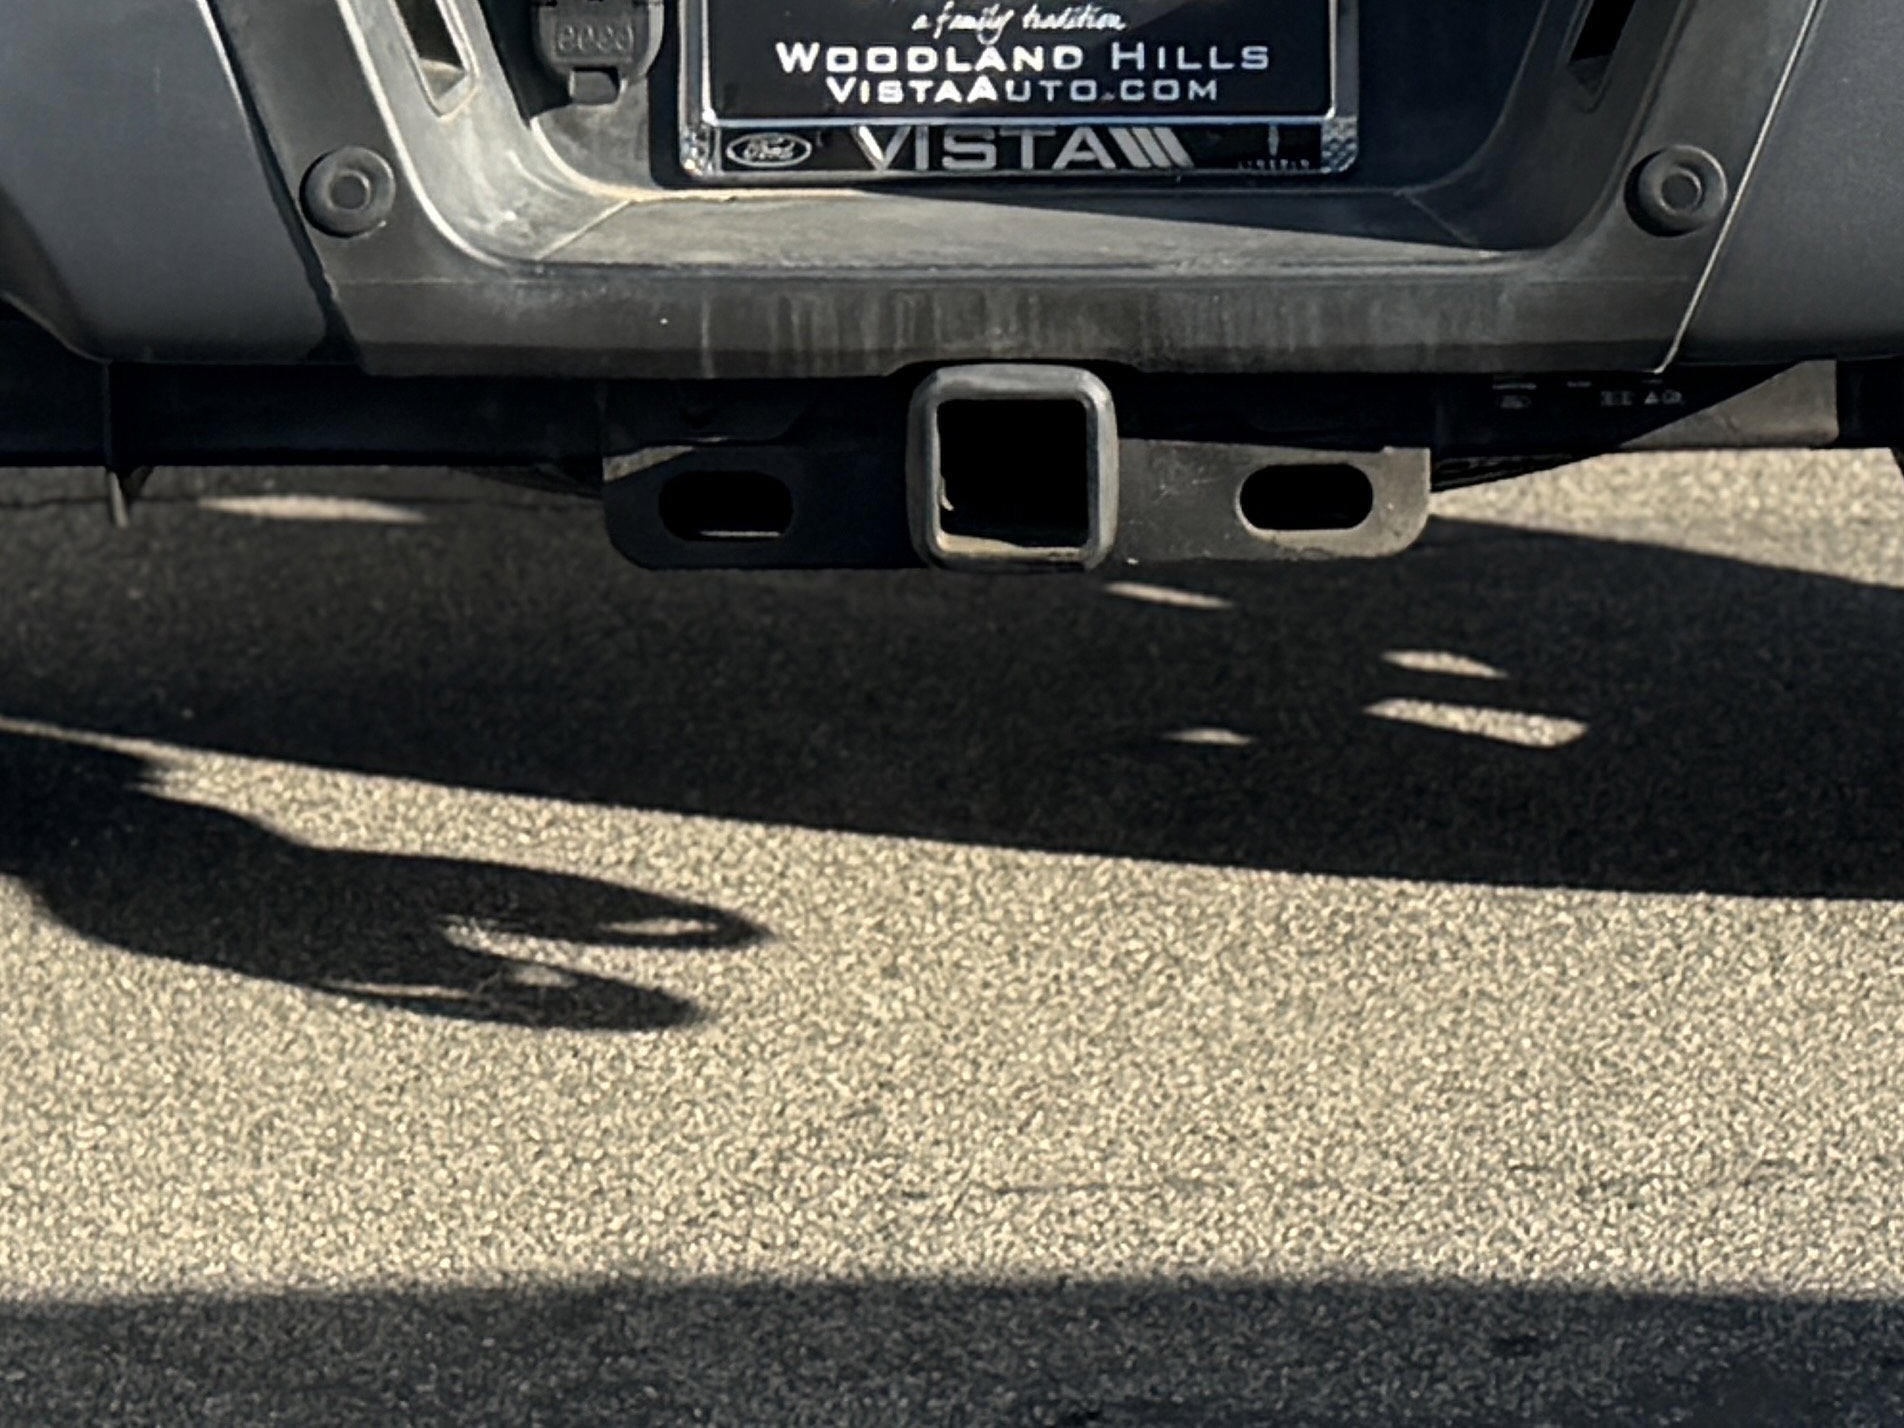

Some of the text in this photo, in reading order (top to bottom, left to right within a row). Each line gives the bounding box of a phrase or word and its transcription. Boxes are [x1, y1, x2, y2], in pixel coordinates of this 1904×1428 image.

[911, 0, 1127, 45] a family tradition
[775, 41, 1270, 73] WOODLAND HILLS
[852, 125, 1116, 171] VISTA
